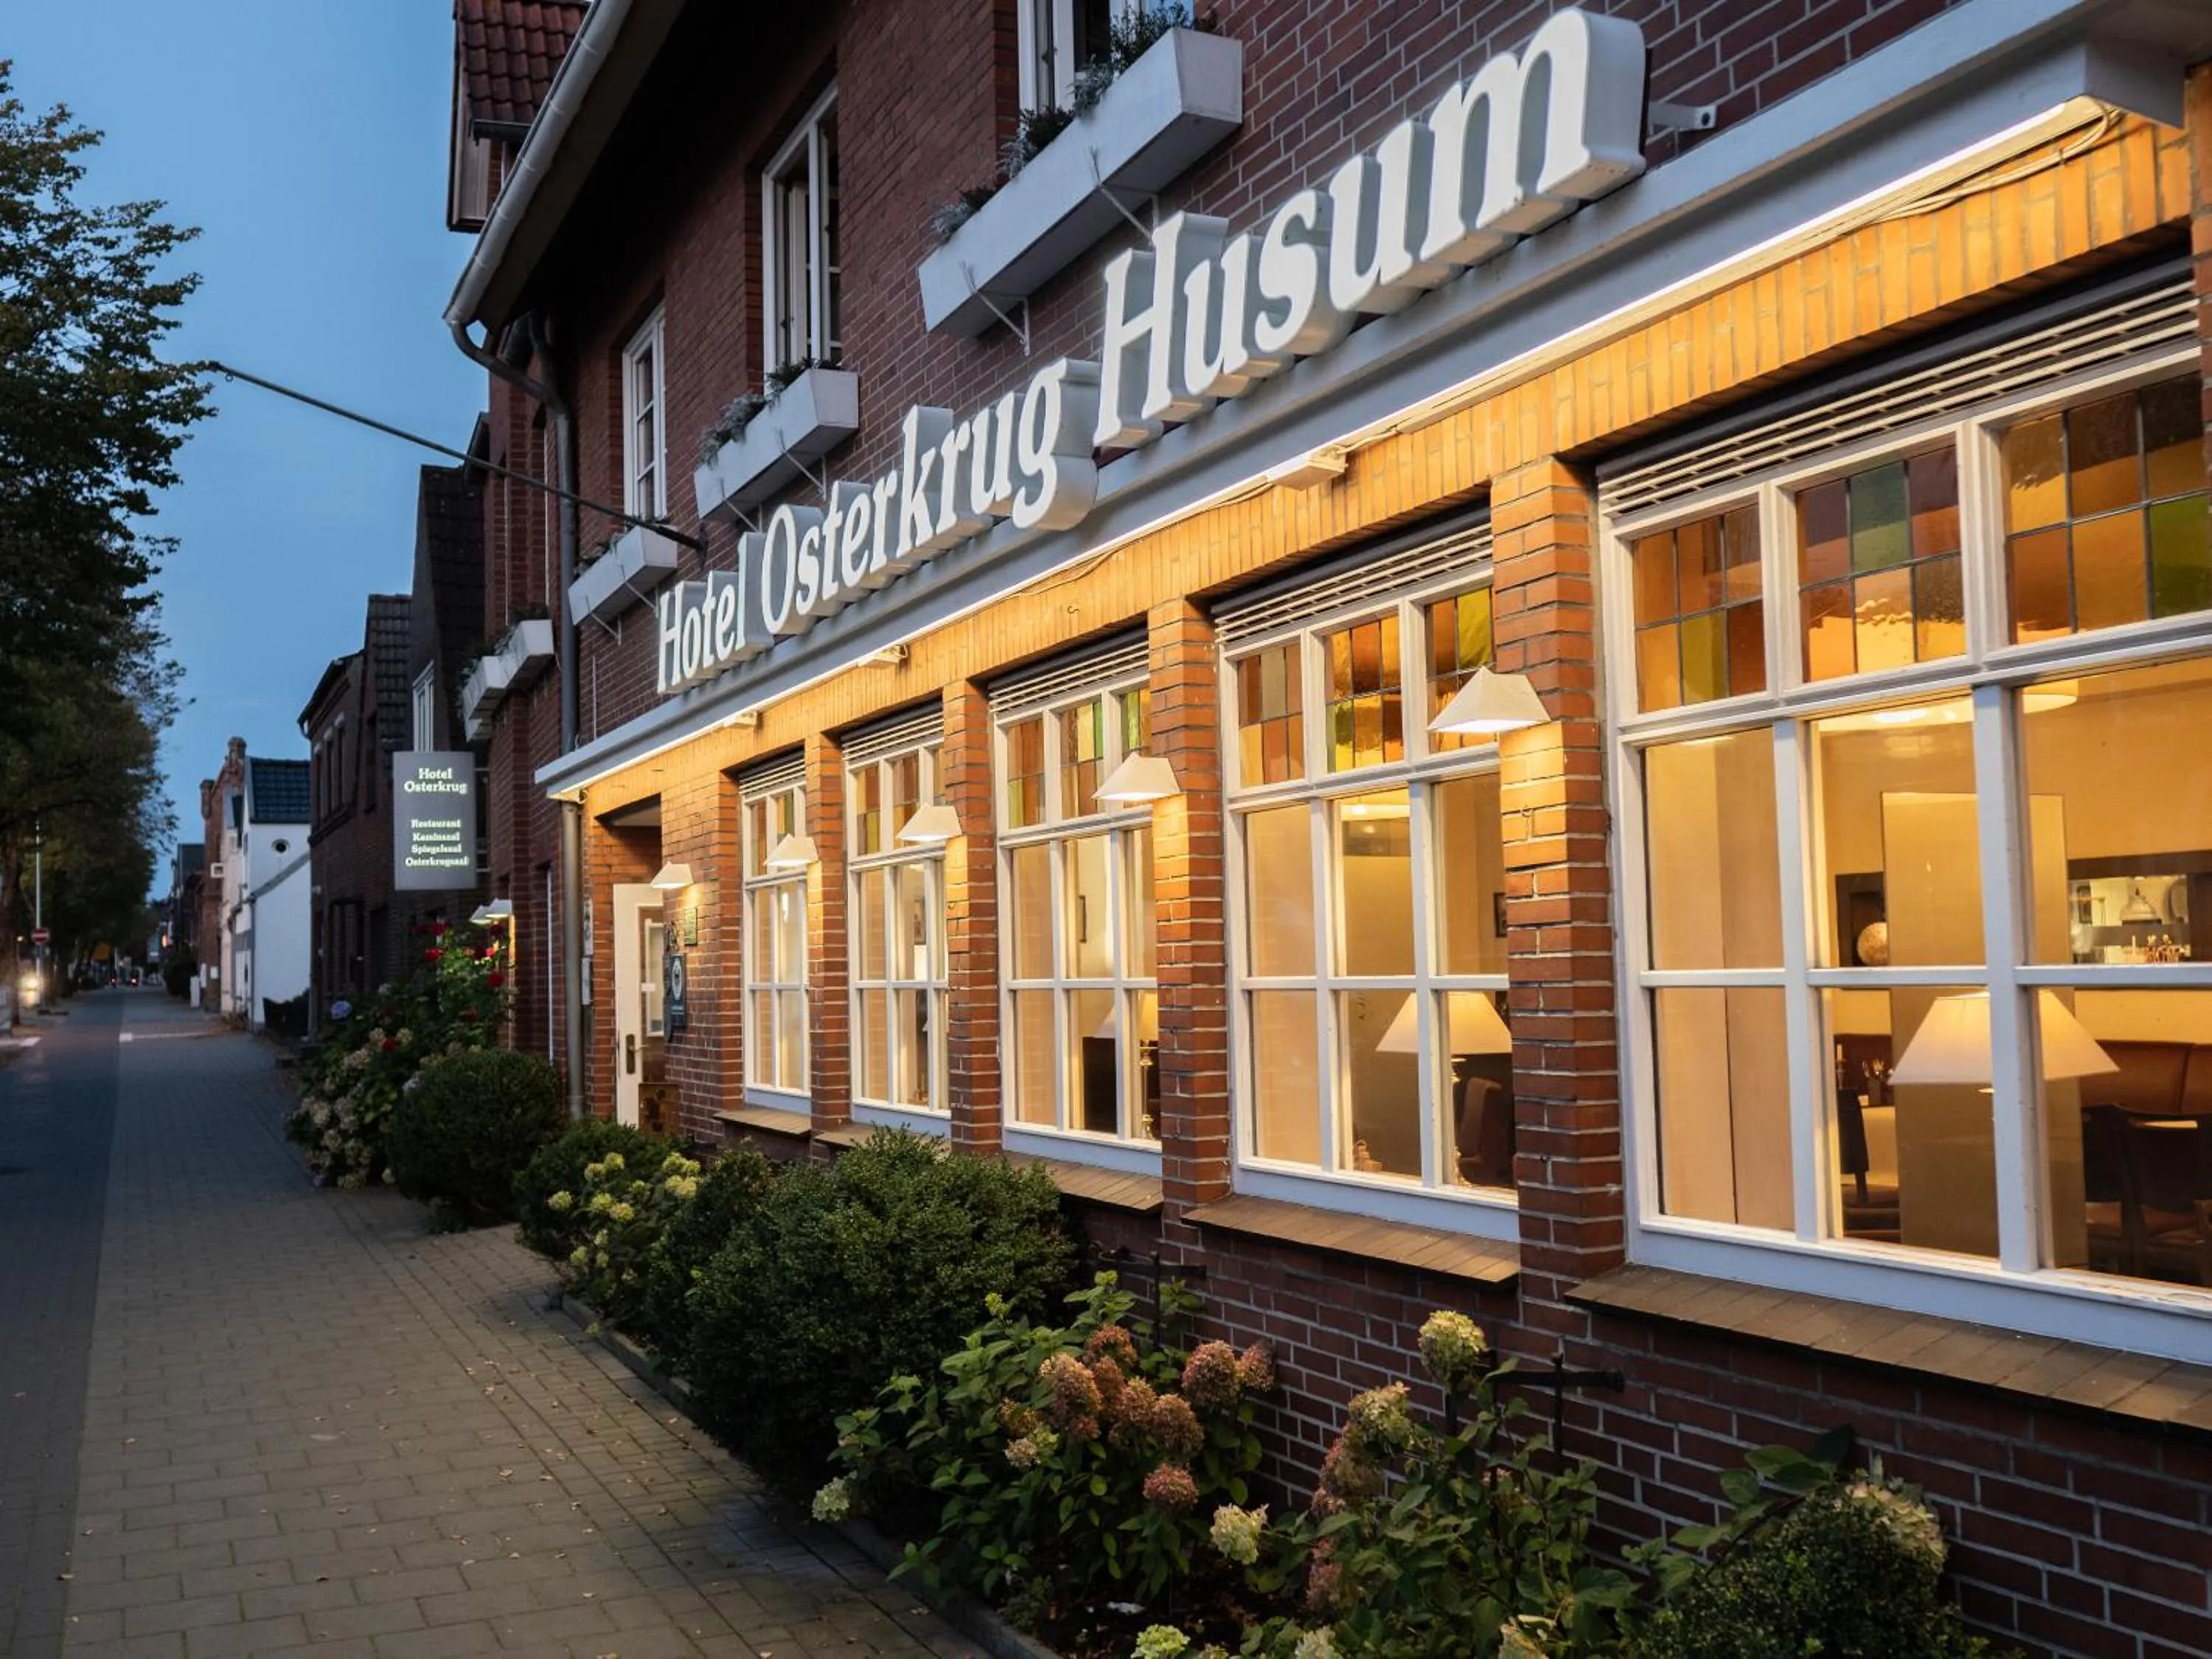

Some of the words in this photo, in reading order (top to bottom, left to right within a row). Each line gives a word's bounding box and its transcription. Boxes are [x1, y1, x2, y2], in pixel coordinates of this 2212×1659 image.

[657, 531, 748, 694] Hotel
[761, 358, 1068, 635] Osterkrug
[1094, 7, 1591, 448] Husum
[418, 768, 453, 780] Hotel
[404, 780, 467, 794] Osterkrug
[411, 819, 462, 828] Restaurant
